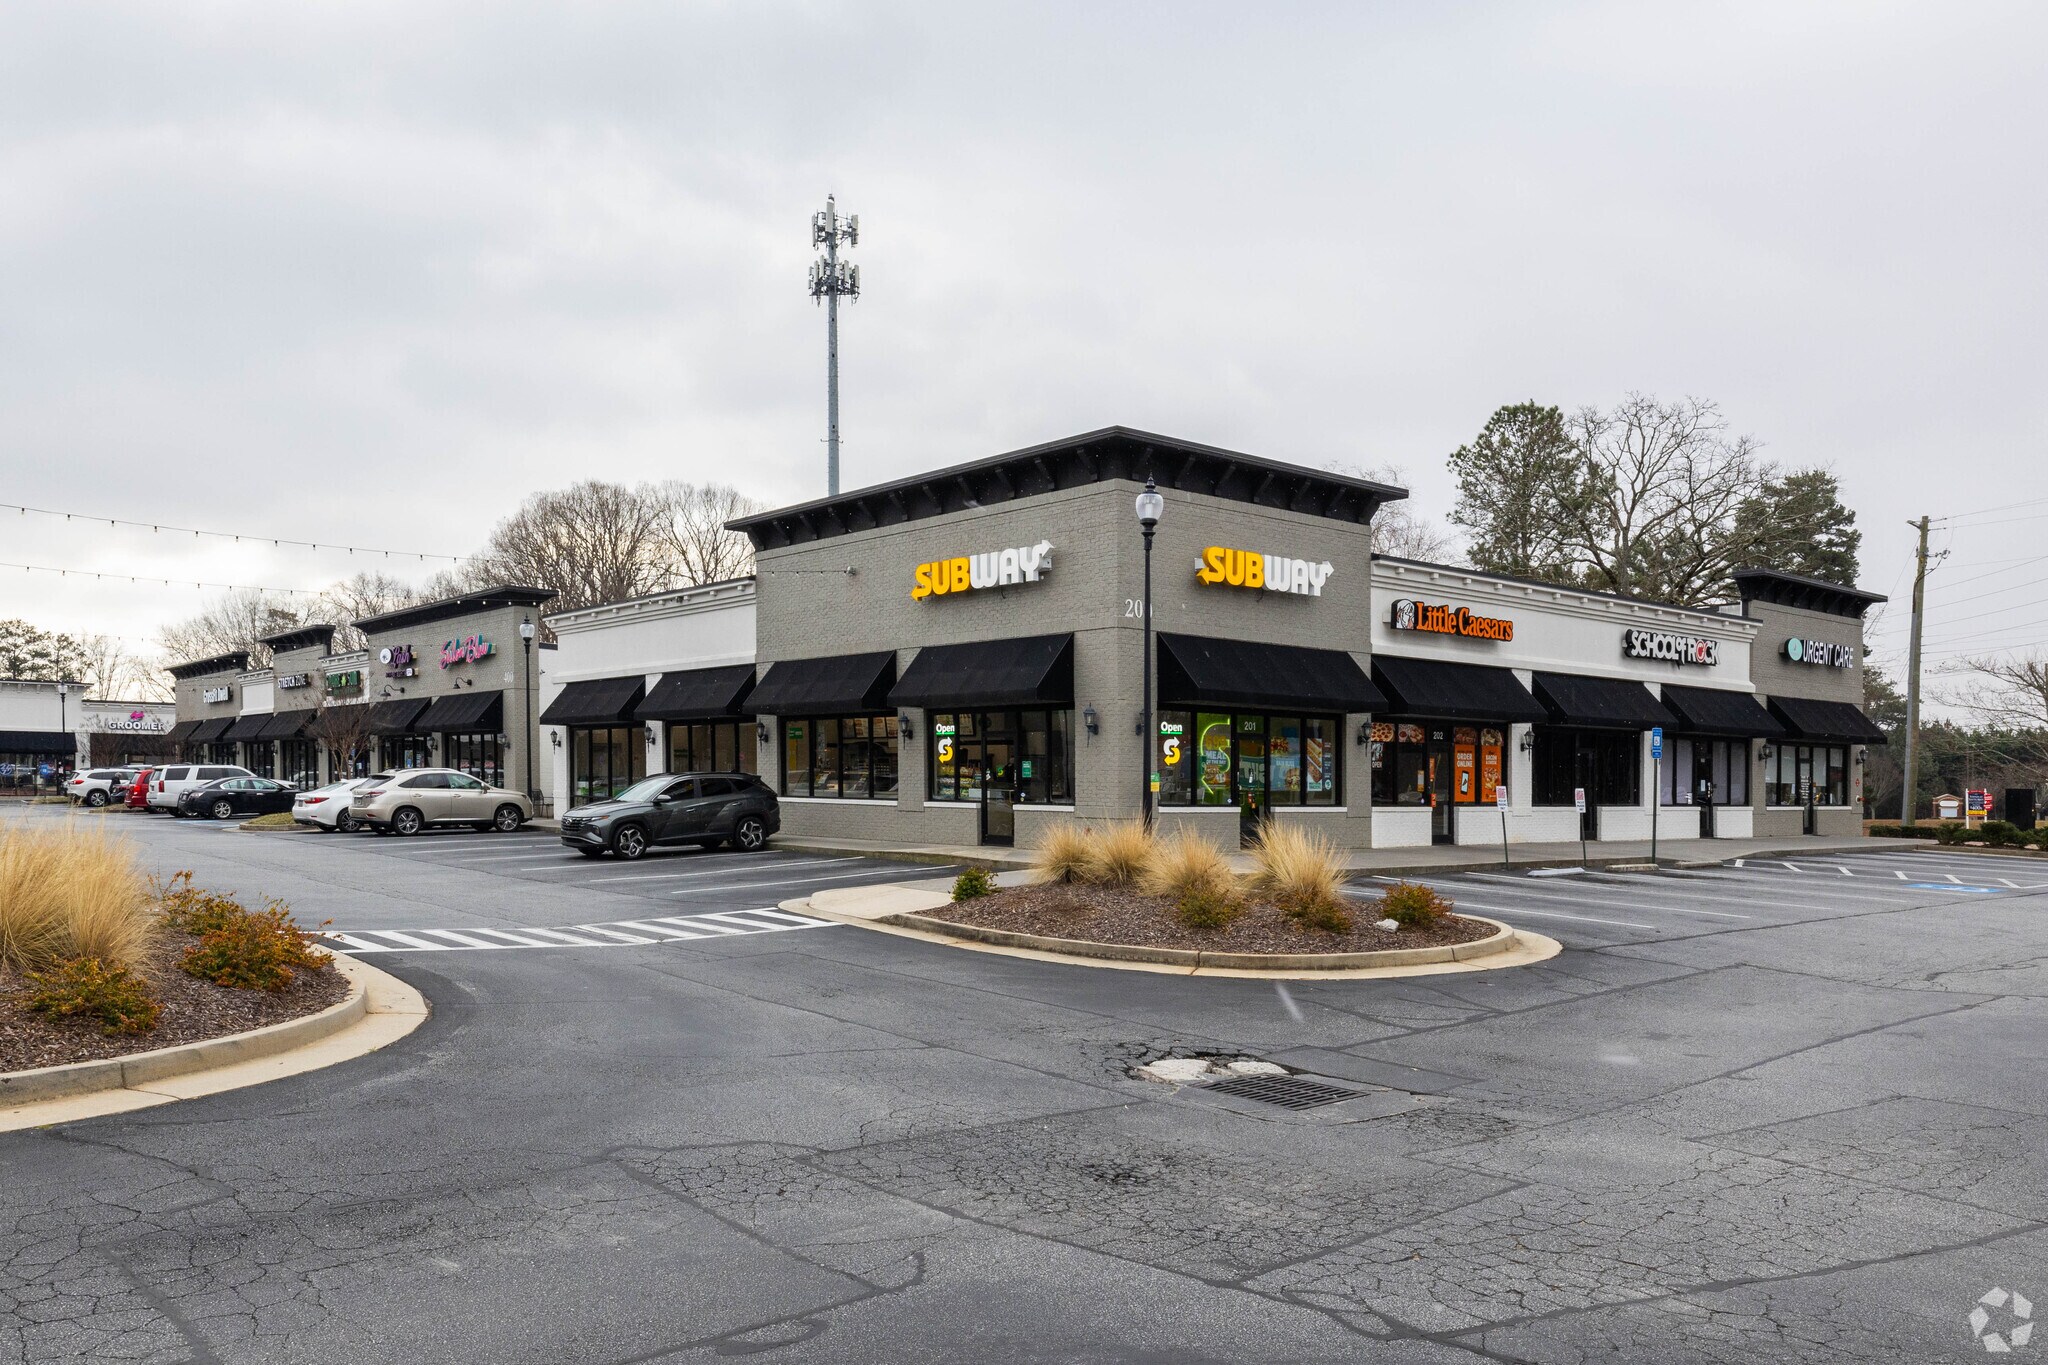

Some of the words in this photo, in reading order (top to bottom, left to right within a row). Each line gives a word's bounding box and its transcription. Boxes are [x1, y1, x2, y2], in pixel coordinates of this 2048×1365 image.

[911, 540, 1054, 602] SUBWAY
[1196, 546, 1334, 597] SUBWAY
[1125, 598, 1153, 618] 20
[1416, 601, 1457, 634] Little
[1458, 607, 1514, 641] Caesars
[1631, 630, 1679, 660] SCHOOL
[1687, 638, 1720, 665] ROCK
[1803, 640, 1833, 666] URGENT
[1834, 645, 1854, 669] CARE
[936, 723, 955, 735] Open
[1160, 721, 1183, 733] Open
[1244, 721, 1256, 731] 201
[1433, 731, 1444, 740] 202
[1206, 750, 1226, 760] MEAL
